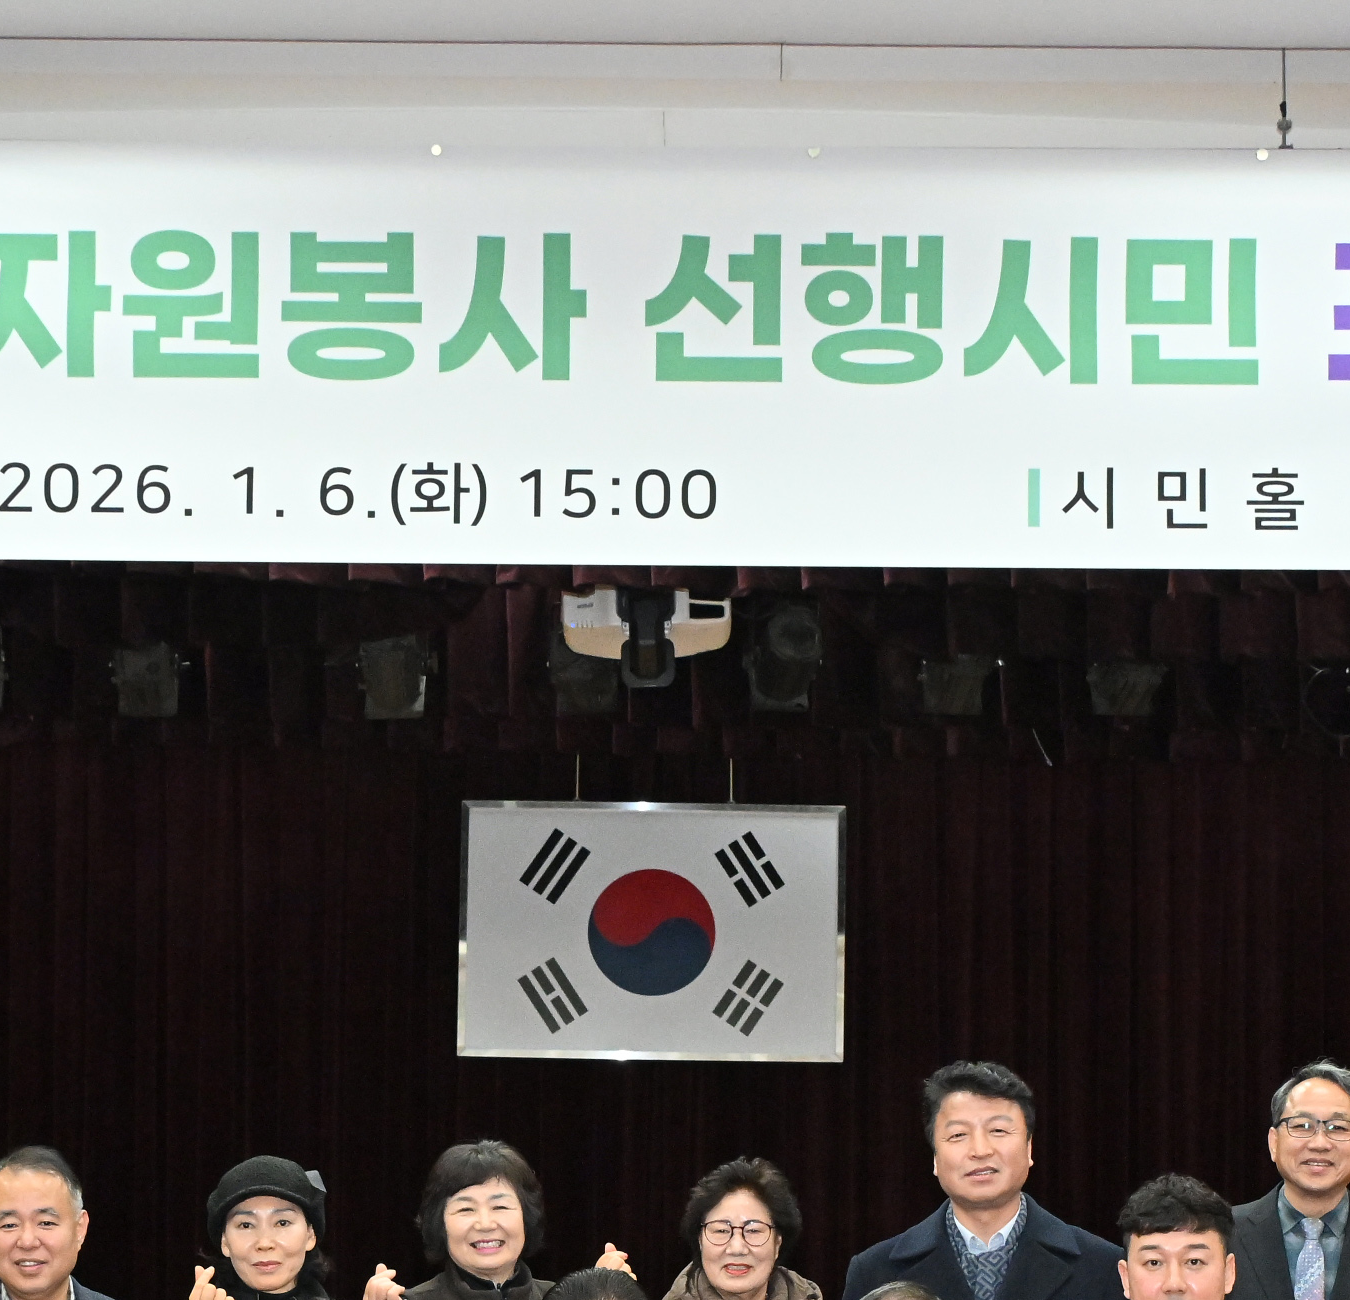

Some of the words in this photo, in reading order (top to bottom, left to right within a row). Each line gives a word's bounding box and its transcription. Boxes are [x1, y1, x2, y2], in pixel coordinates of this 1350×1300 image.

[644, 231, 1259, 386] 선행시민
[0, 462, 193, 516] 2026.
[233, 466, 285, 517] 1.
[519, 468, 717, 520] 15:00
